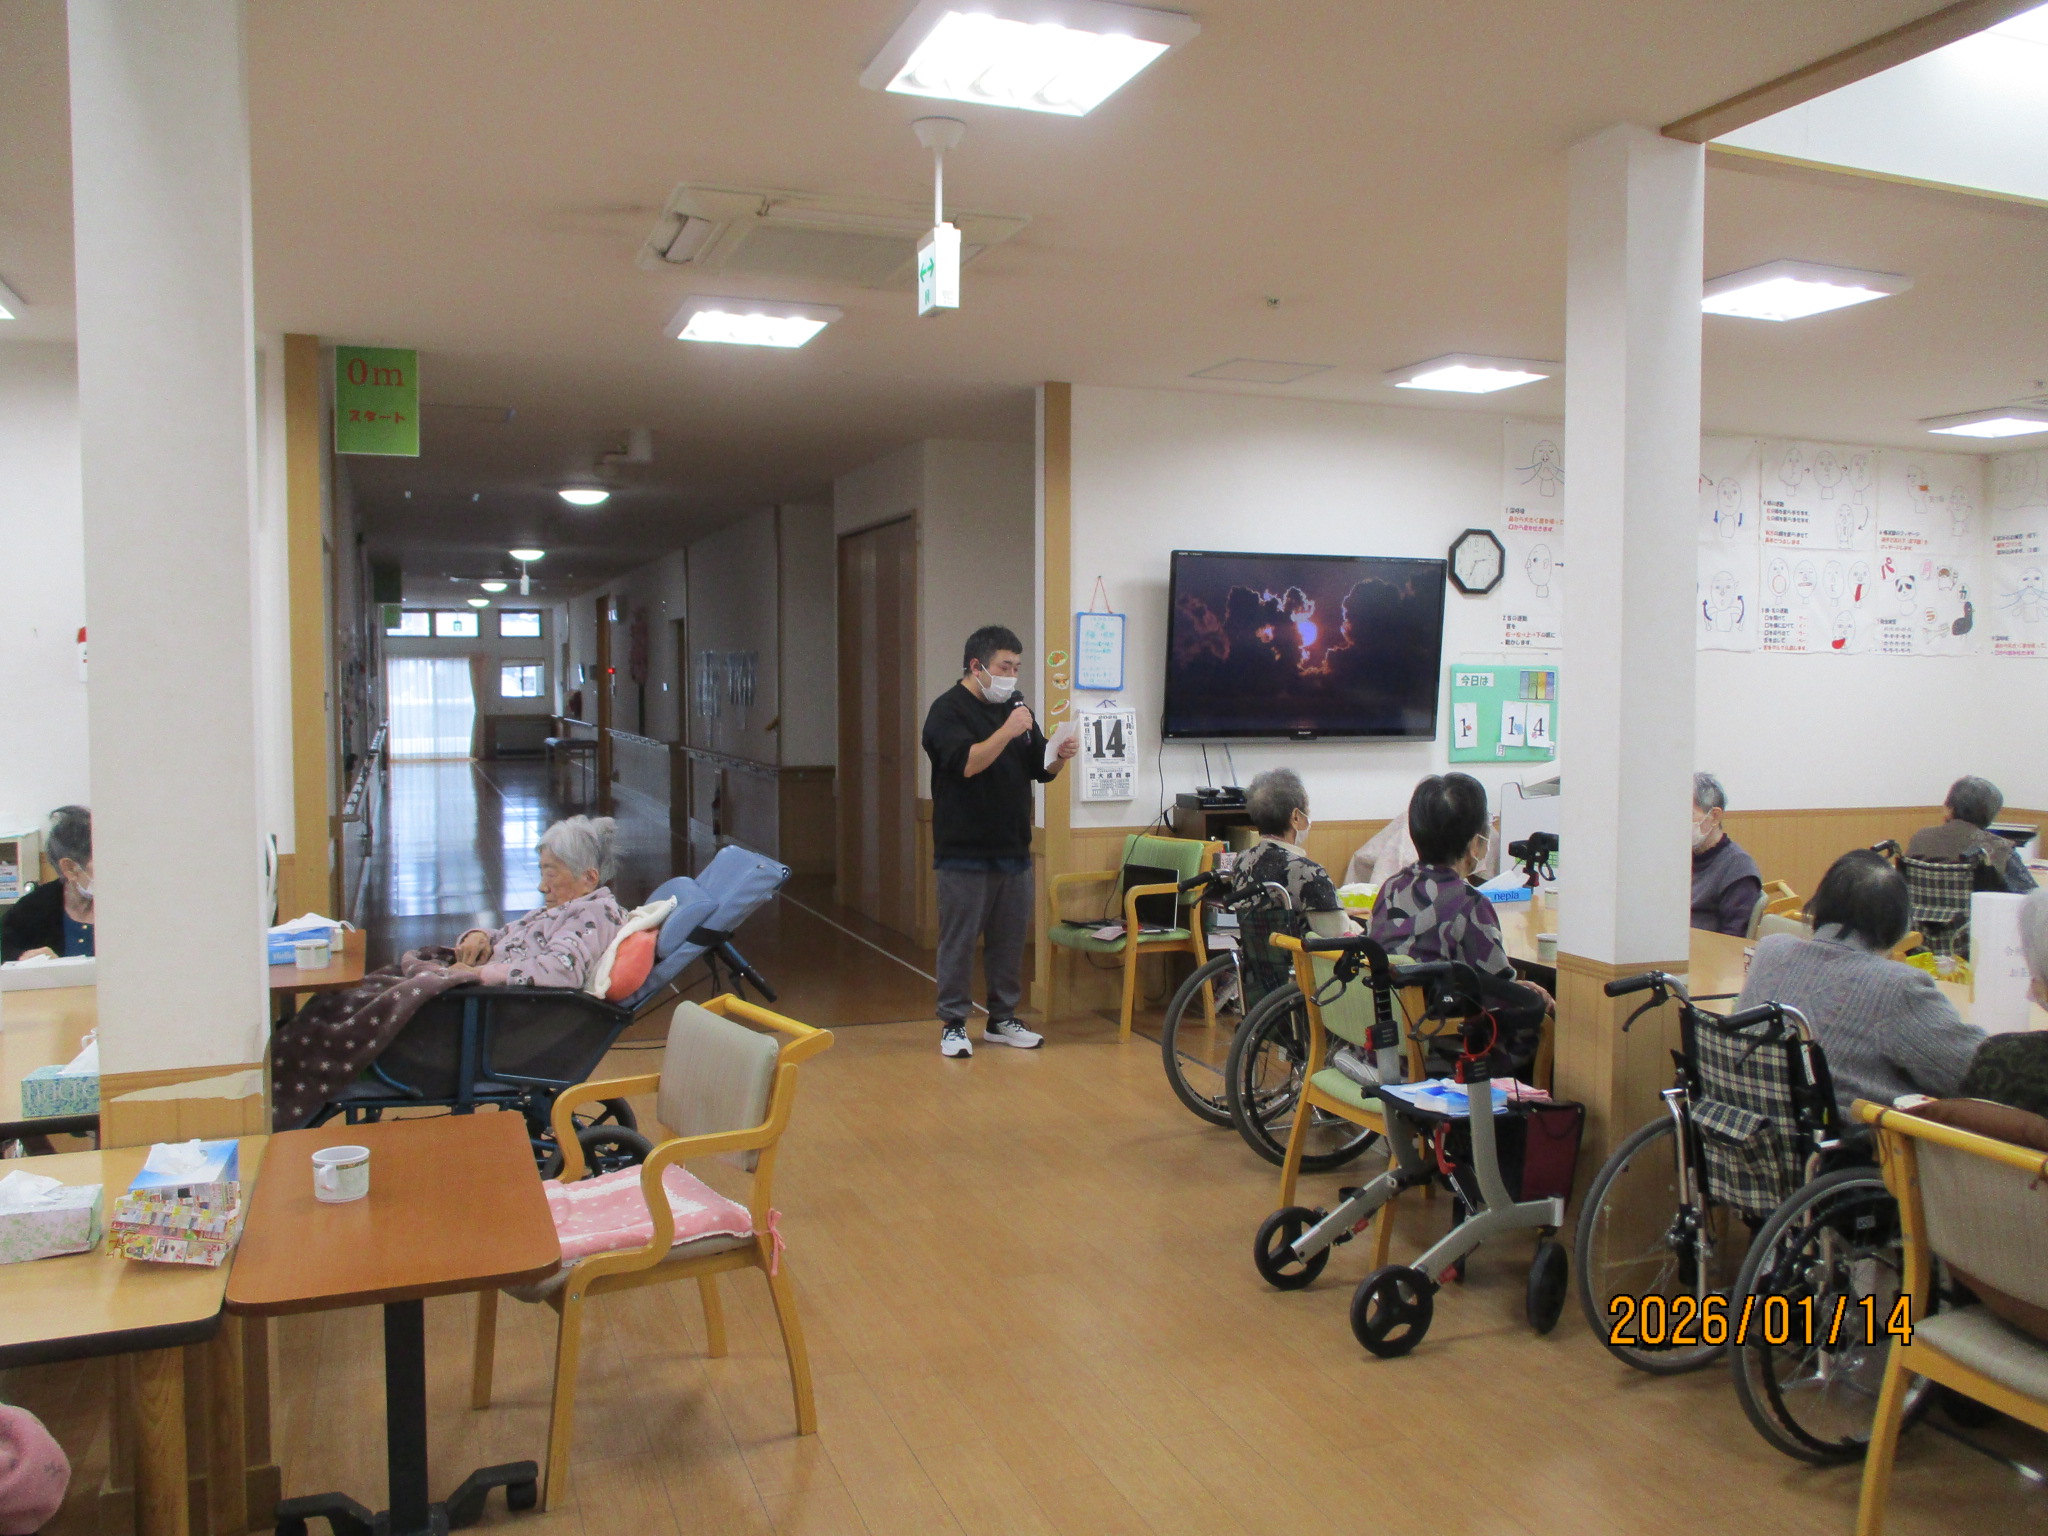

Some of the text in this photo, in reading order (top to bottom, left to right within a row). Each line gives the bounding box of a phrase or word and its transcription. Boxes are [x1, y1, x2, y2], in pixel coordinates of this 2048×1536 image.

[347, 358, 405, 387] 0m
[349, 409, 406, 424] スタート
[1959, 585, 1967, 600] カ
[1461, 675, 1489, 686] 今日は
[1092, 719, 1126, 758] 14
